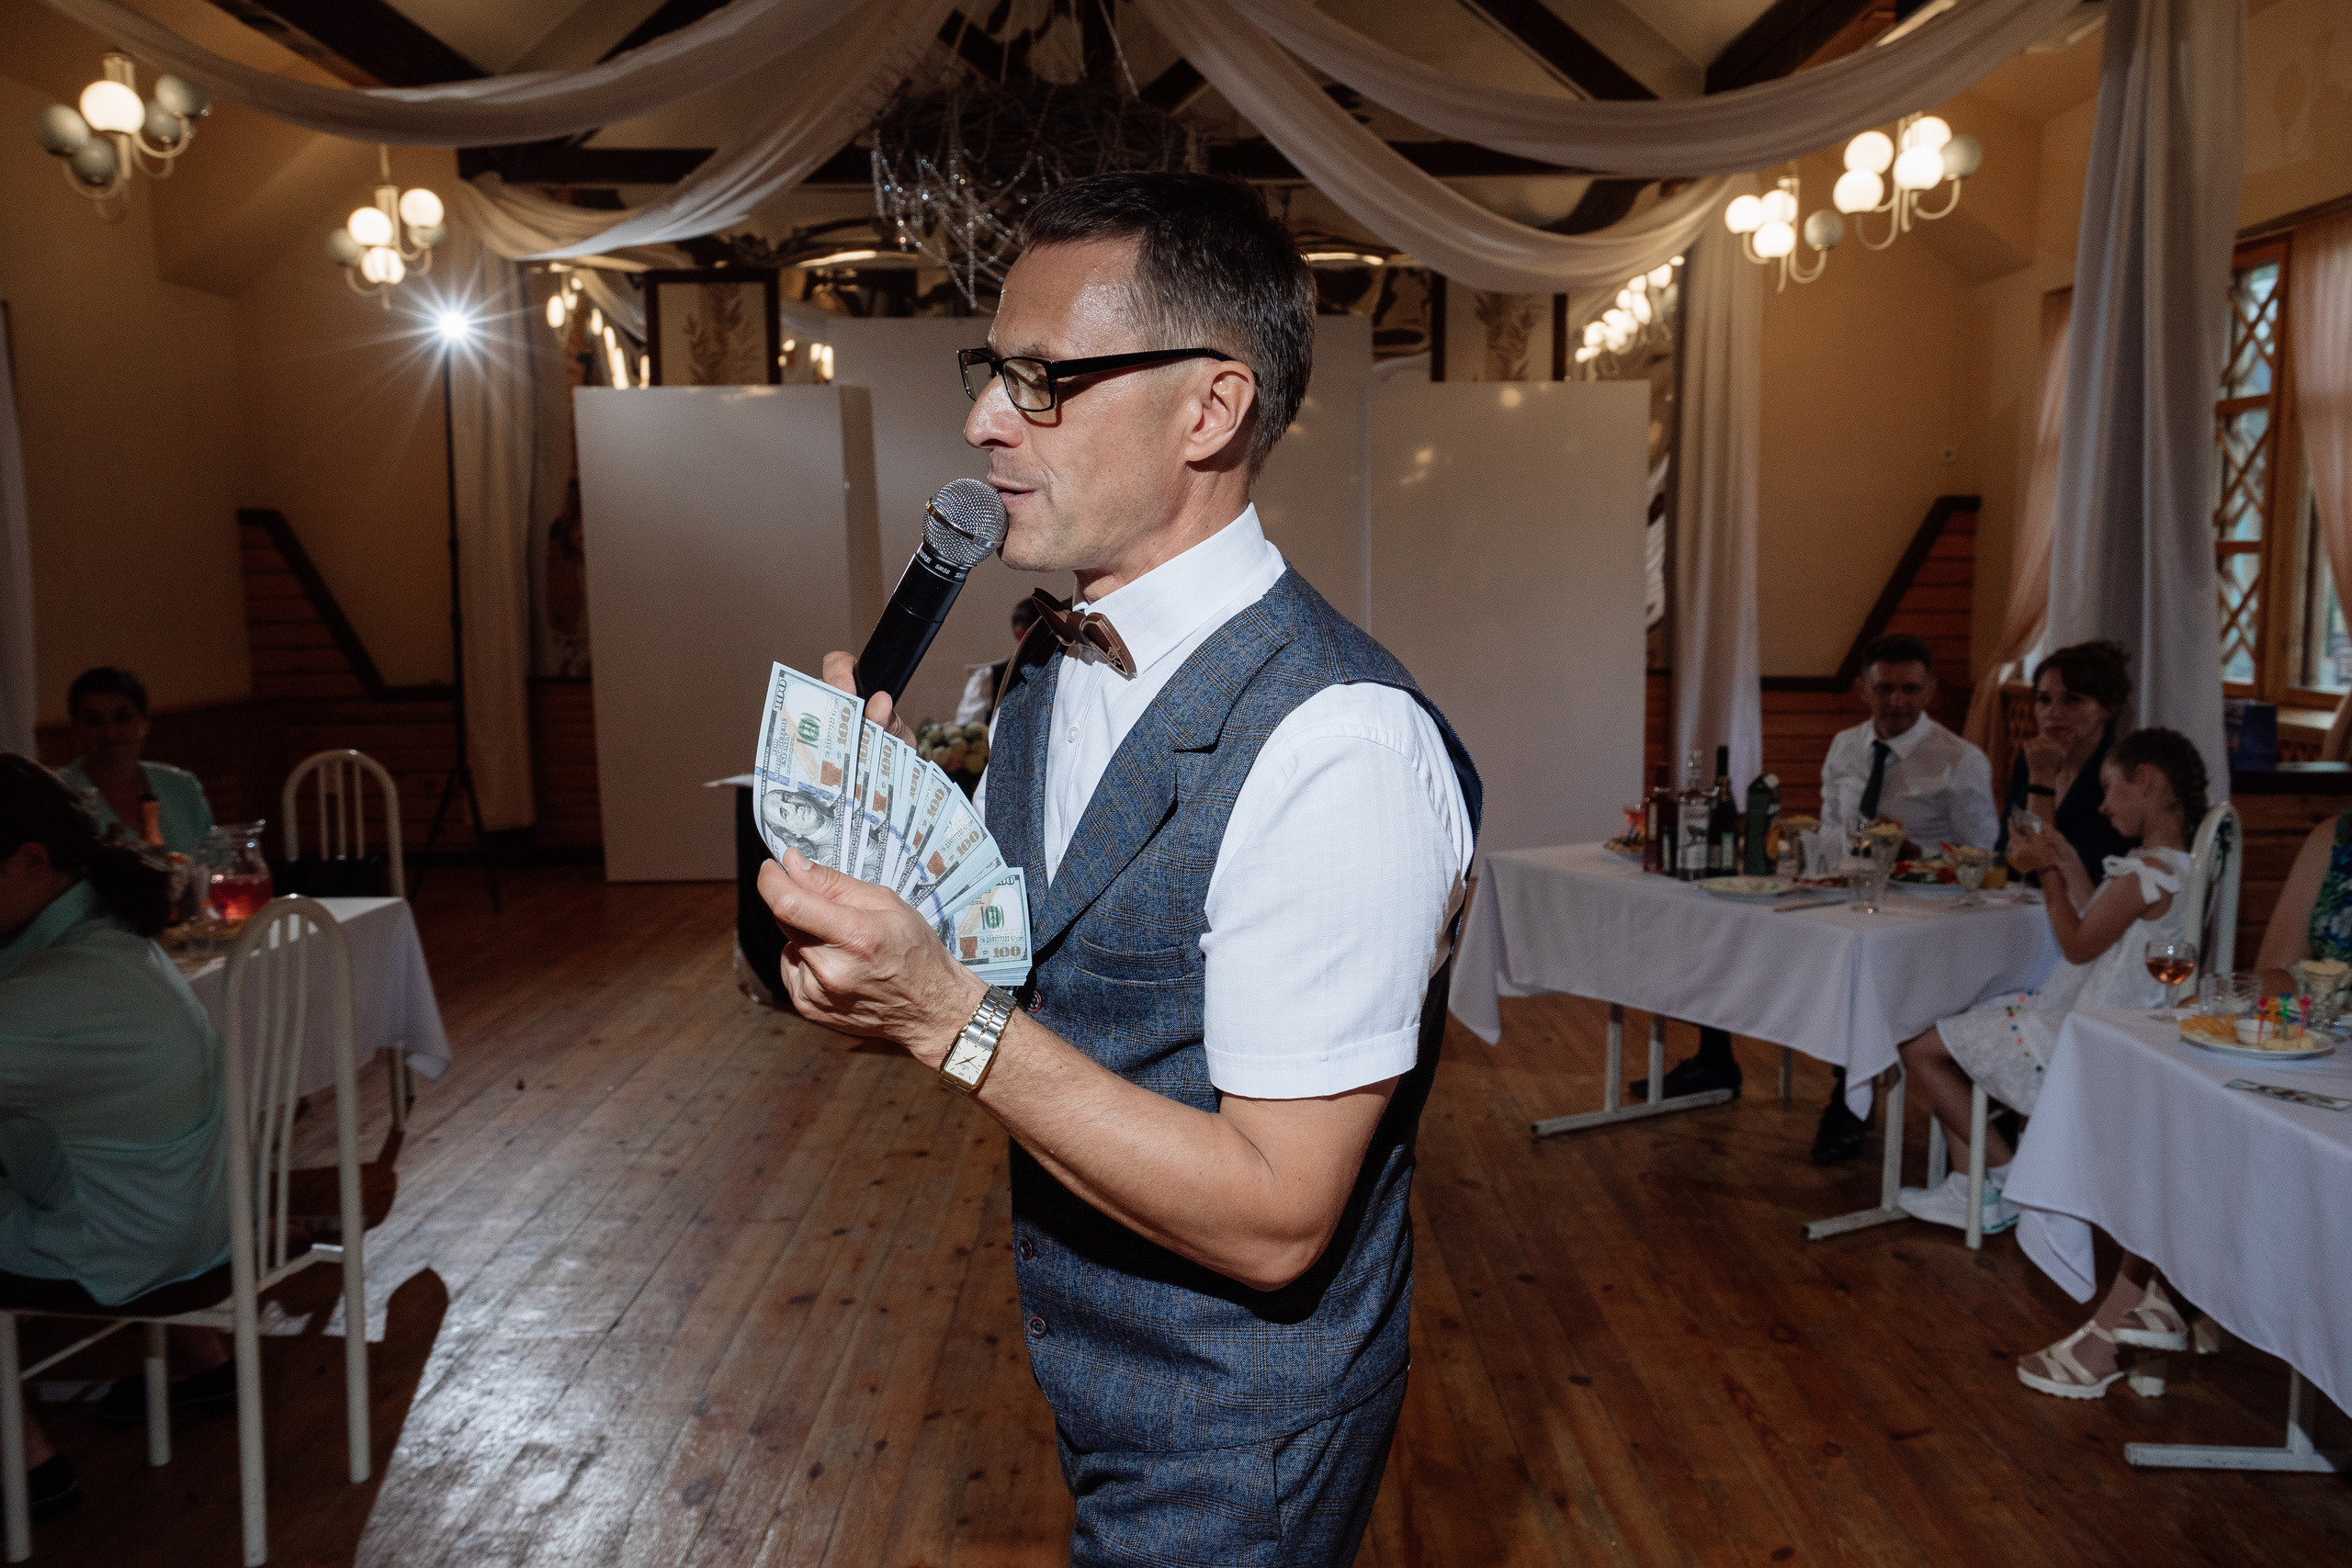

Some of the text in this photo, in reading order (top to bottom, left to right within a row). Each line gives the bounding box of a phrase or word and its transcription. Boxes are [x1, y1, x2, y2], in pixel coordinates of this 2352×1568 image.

[934, 563, 950, 575] SM58
[775, 679, 787, 711] 100
[837, 706, 851, 746] 100
[859, 730, 870, 765] 100
[880, 744, 892, 779] 100
[927, 788, 944, 818] 100
[956, 830, 979, 857] 100
[993, 945, 1021, 958] 100
